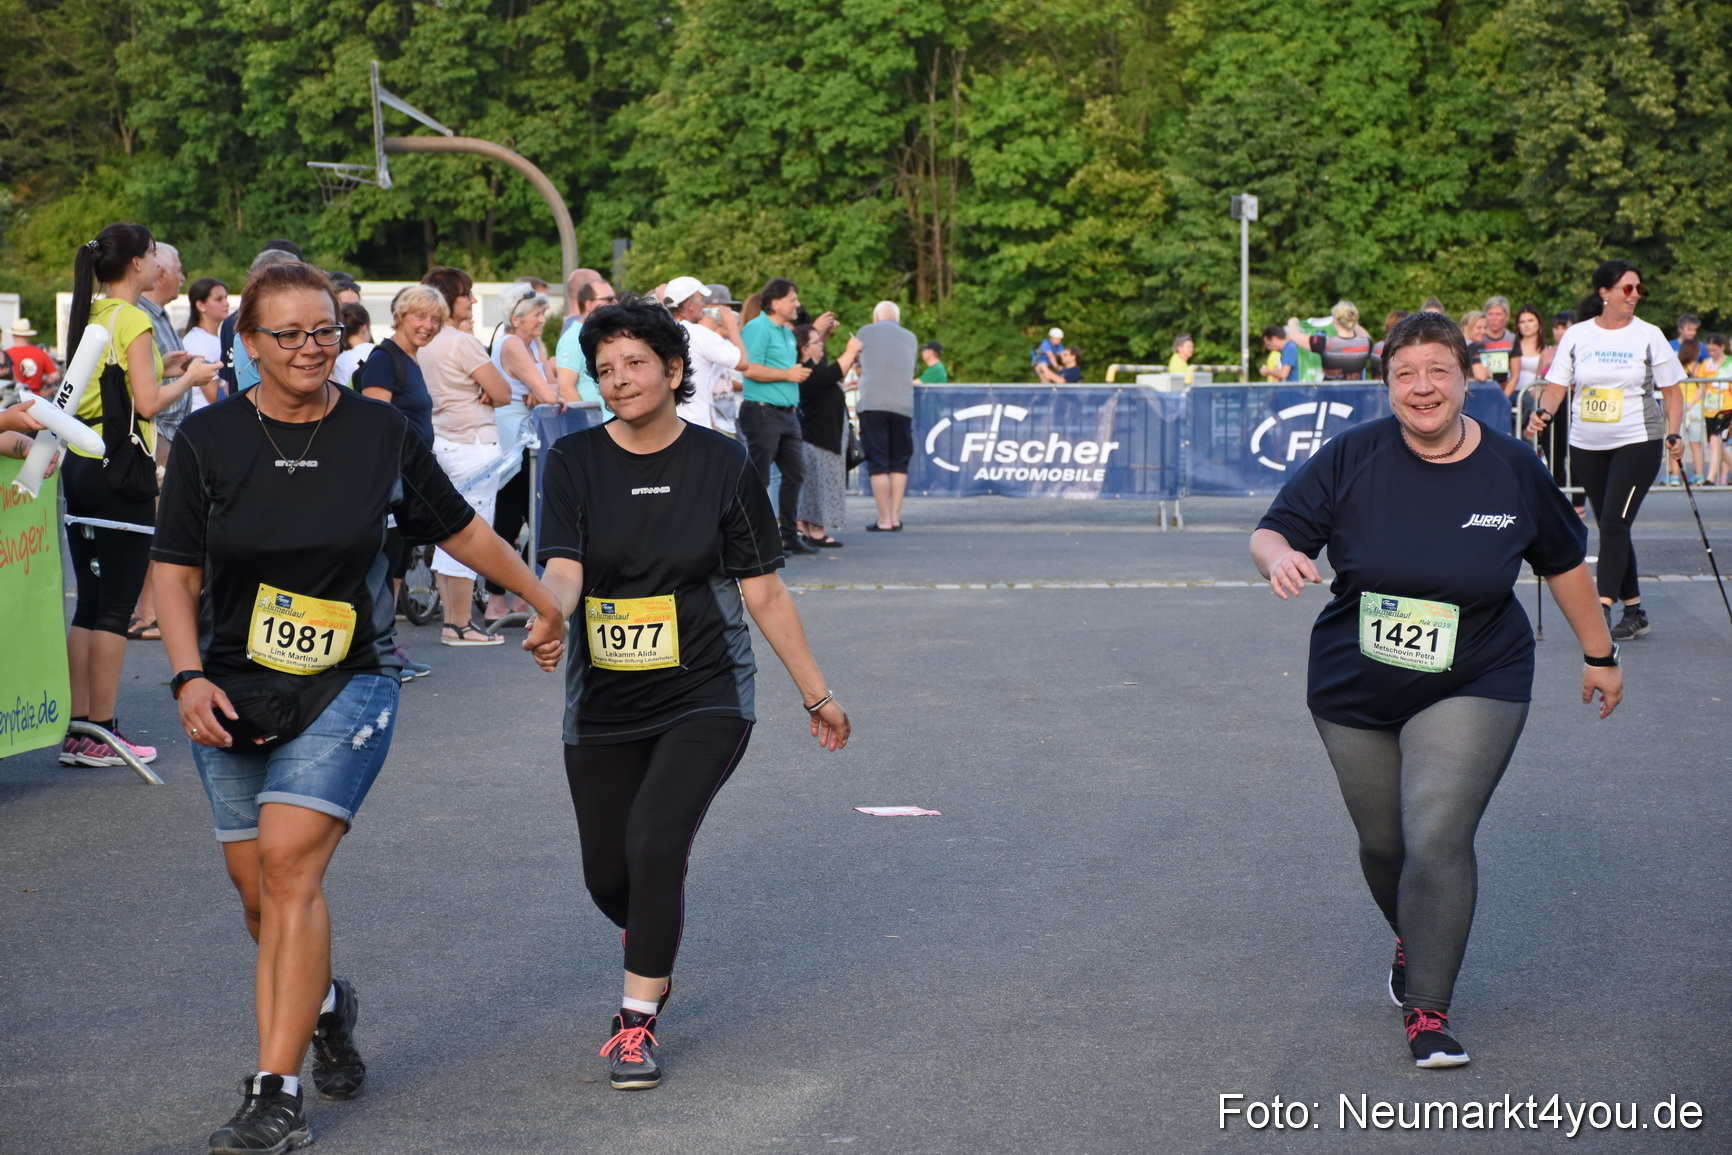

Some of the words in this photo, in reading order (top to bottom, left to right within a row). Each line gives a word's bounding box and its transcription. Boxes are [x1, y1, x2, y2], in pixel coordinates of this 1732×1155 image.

[1594, 350, 1634, 359] HAUBNER
[1585, 400, 1616, 413] 1006
[959, 432, 1120, 464] Fischer
[1286, 431, 1333, 461] Fi
[973, 467, 1106, 482] AUTOMOBILE
[263, 616, 335, 656] 1981
[596, 622, 664, 650] 1977
[1370, 618, 1439, 653] 1421
[270, 647, 286, 657] Link
[287, 652, 318, 663] Martina
[605, 650, 636, 658] Leikamm
[637, 650, 657, 658] Alida
[1373, 642, 1414, 657] Metschovin
[1415, 651, 1435, 661] Petra
